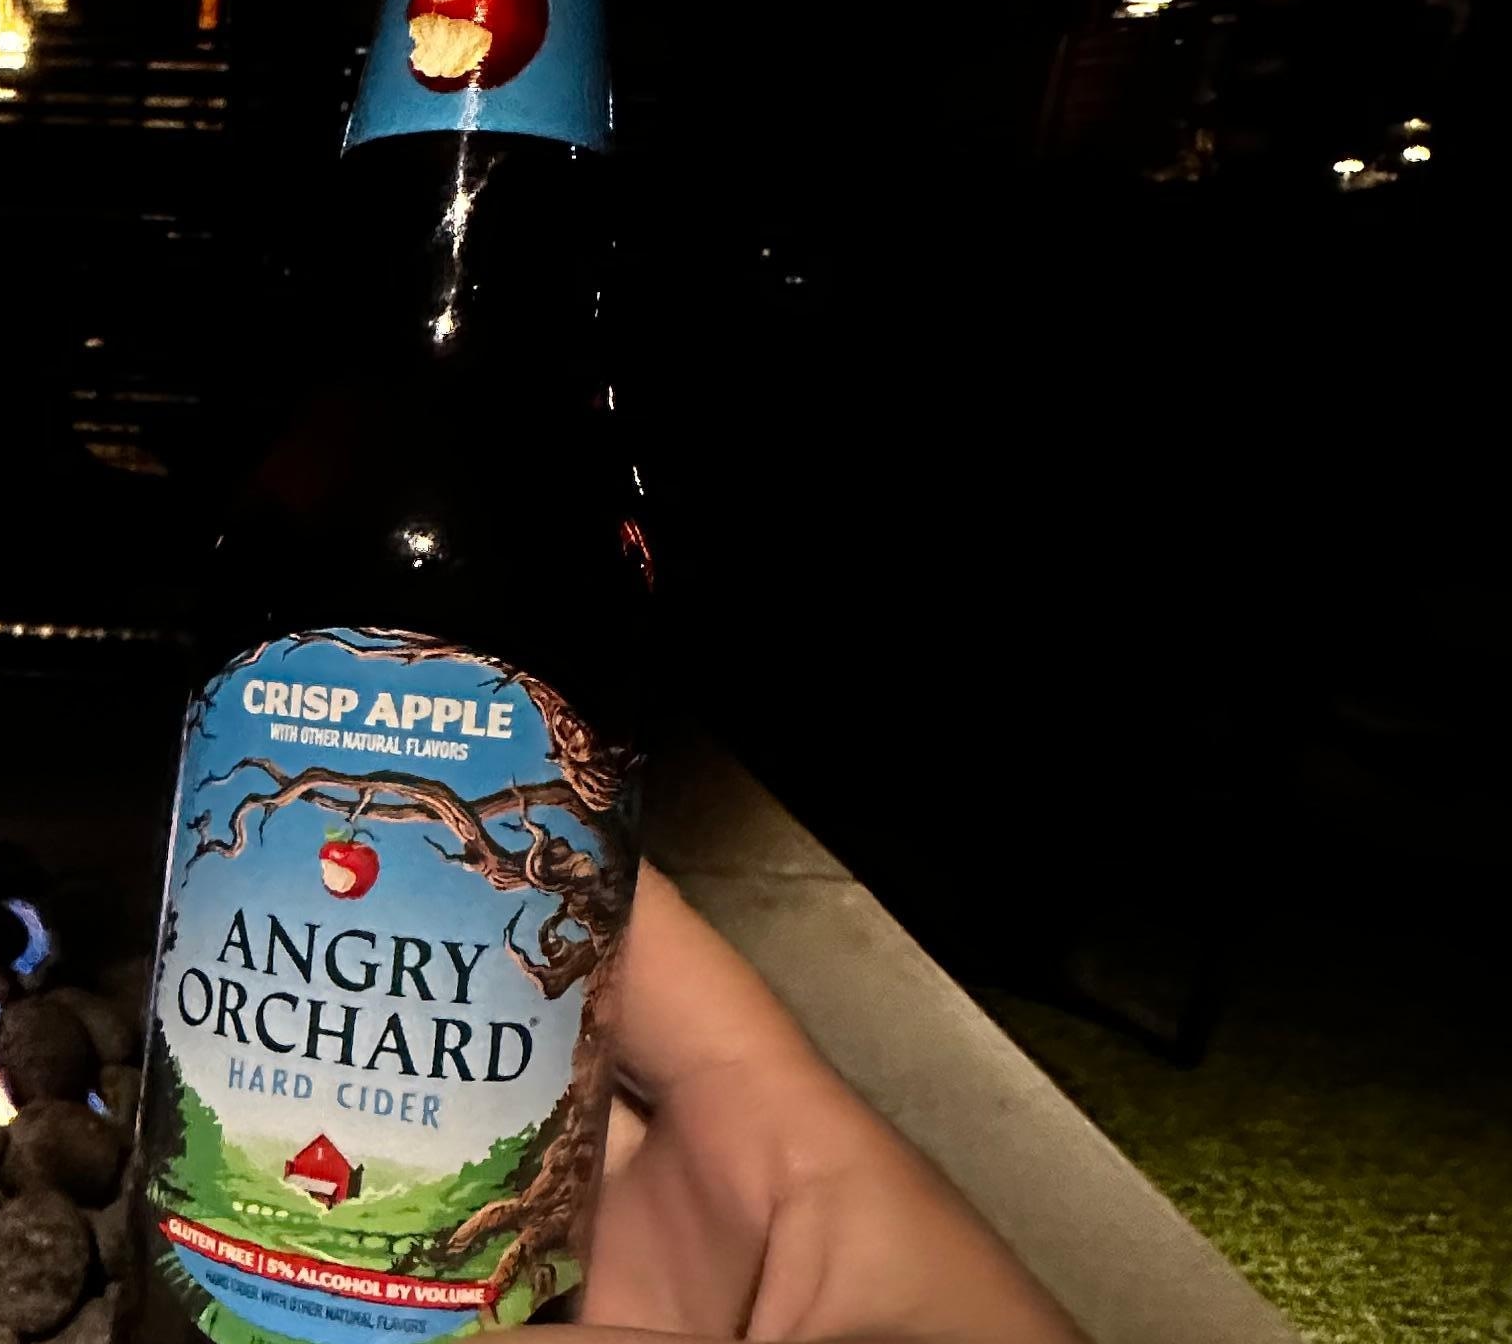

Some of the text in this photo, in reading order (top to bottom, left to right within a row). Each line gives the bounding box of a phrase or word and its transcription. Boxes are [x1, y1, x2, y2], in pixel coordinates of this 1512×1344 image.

[242, 679, 514, 739] CRISP APPLE
[270, 723, 470, 761] WITH OTHER NATURAL FLAVORS
[217, 908, 488, 1005] ANGRY
[178, 968, 534, 1083] ORCHARD
[228, 1058, 441, 1129] HARD CIDER
[168, 1218, 486, 1304] GLUTEN FREE 5% ALCOHOL BY VOLUME
[261, 1290, 287, 1309] WITH
[289, 1296, 322, 1318] OTHER
[325, 1308, 375, 1330] NATURAL
[376, 1314, 427, 1334] FLAVORS
